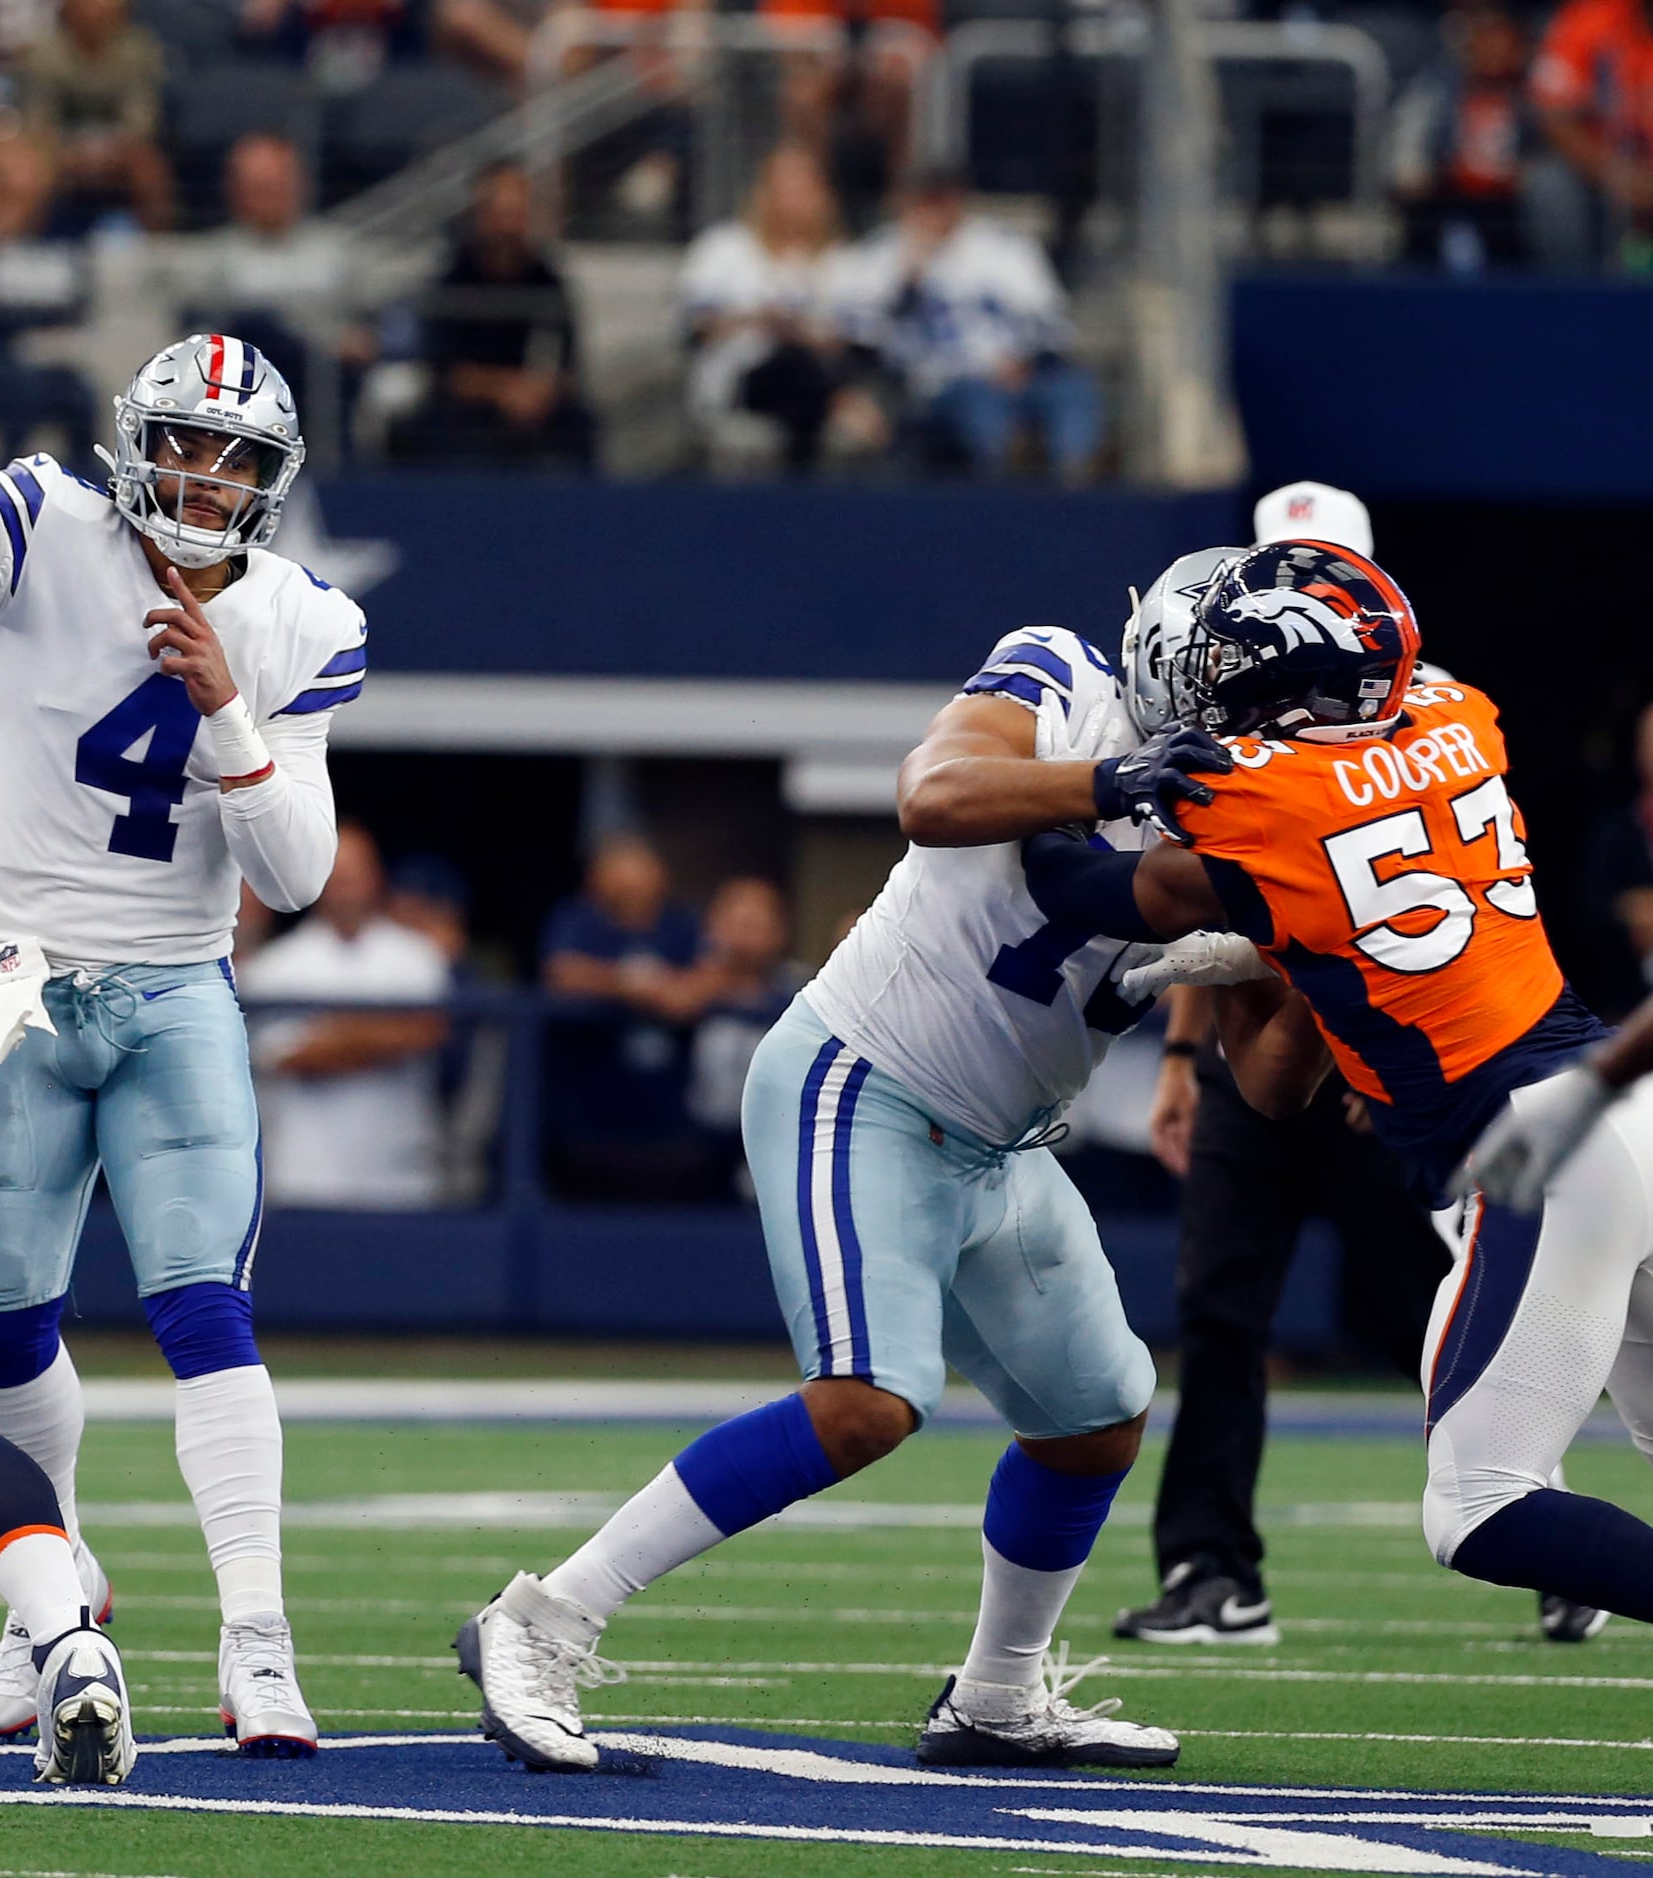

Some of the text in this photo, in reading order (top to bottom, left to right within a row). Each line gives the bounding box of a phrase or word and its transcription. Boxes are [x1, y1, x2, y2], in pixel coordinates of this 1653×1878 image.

[74, 671, 203, 863] 4
[1332, 722, 1489, 806] COOPER
[1320, 774, 1538, 976] 53
